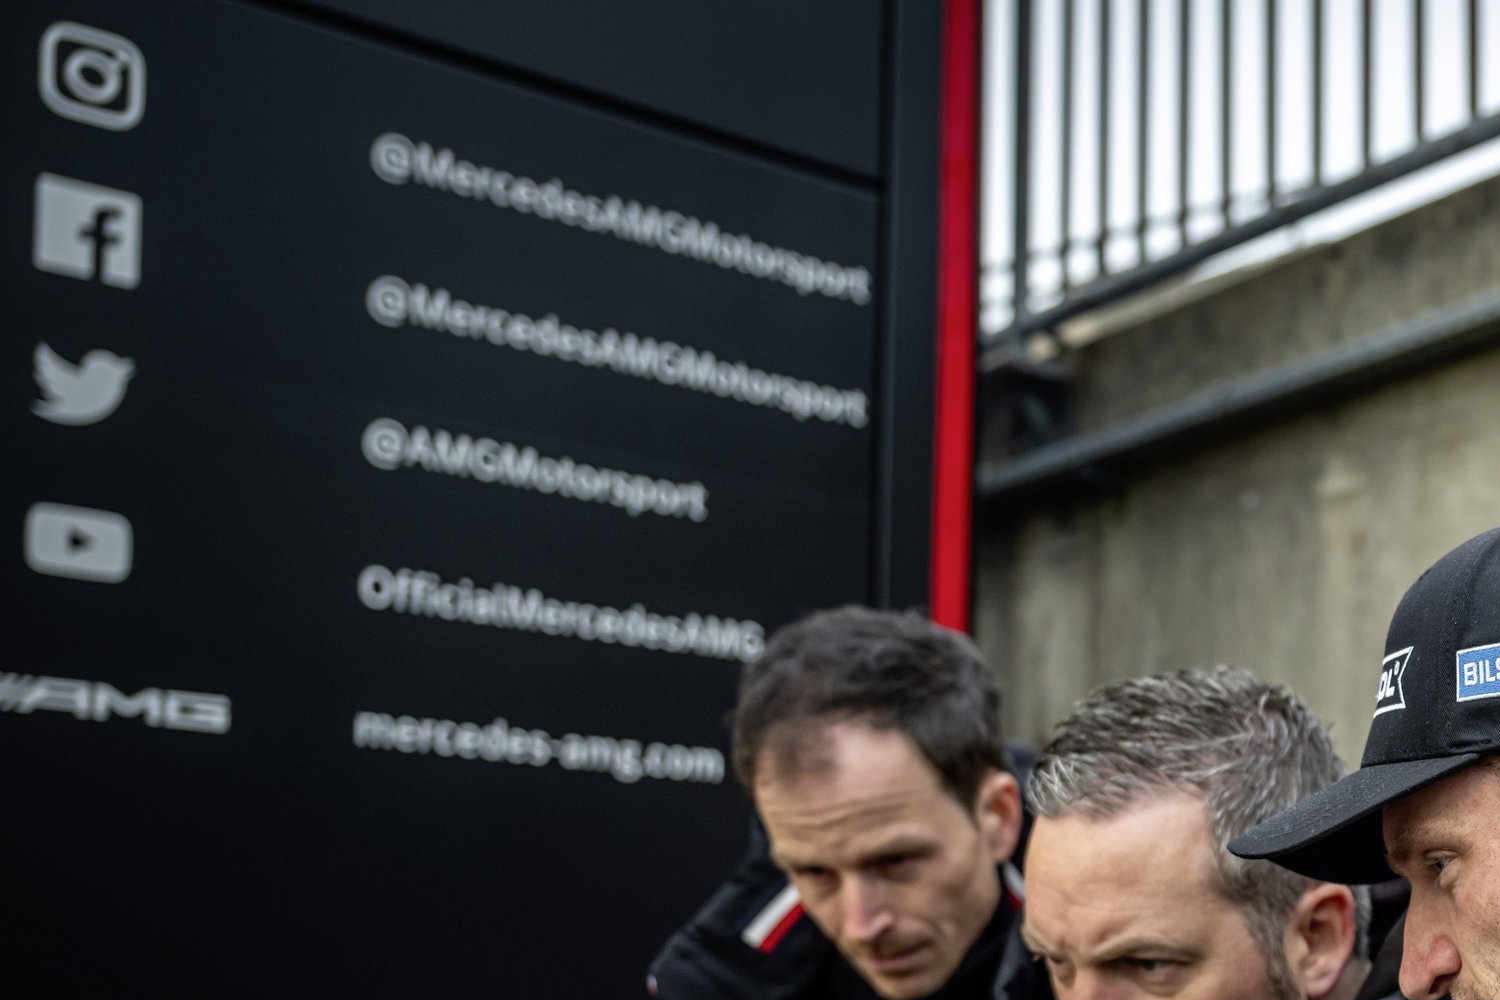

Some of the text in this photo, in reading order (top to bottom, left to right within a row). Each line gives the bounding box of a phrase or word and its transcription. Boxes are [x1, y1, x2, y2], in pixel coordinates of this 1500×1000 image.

[368, 132, 872, 305] @MercedesAMGMotorsport
[365, 275, 870, 428] @MercedesAMGMotorsport
[361, 417, 709, 522] @AMGMotorsport
[357, 564, 766, 664] OfficialMercedesAMG
[353, 711, 725, 783] mercedes-amg.com
